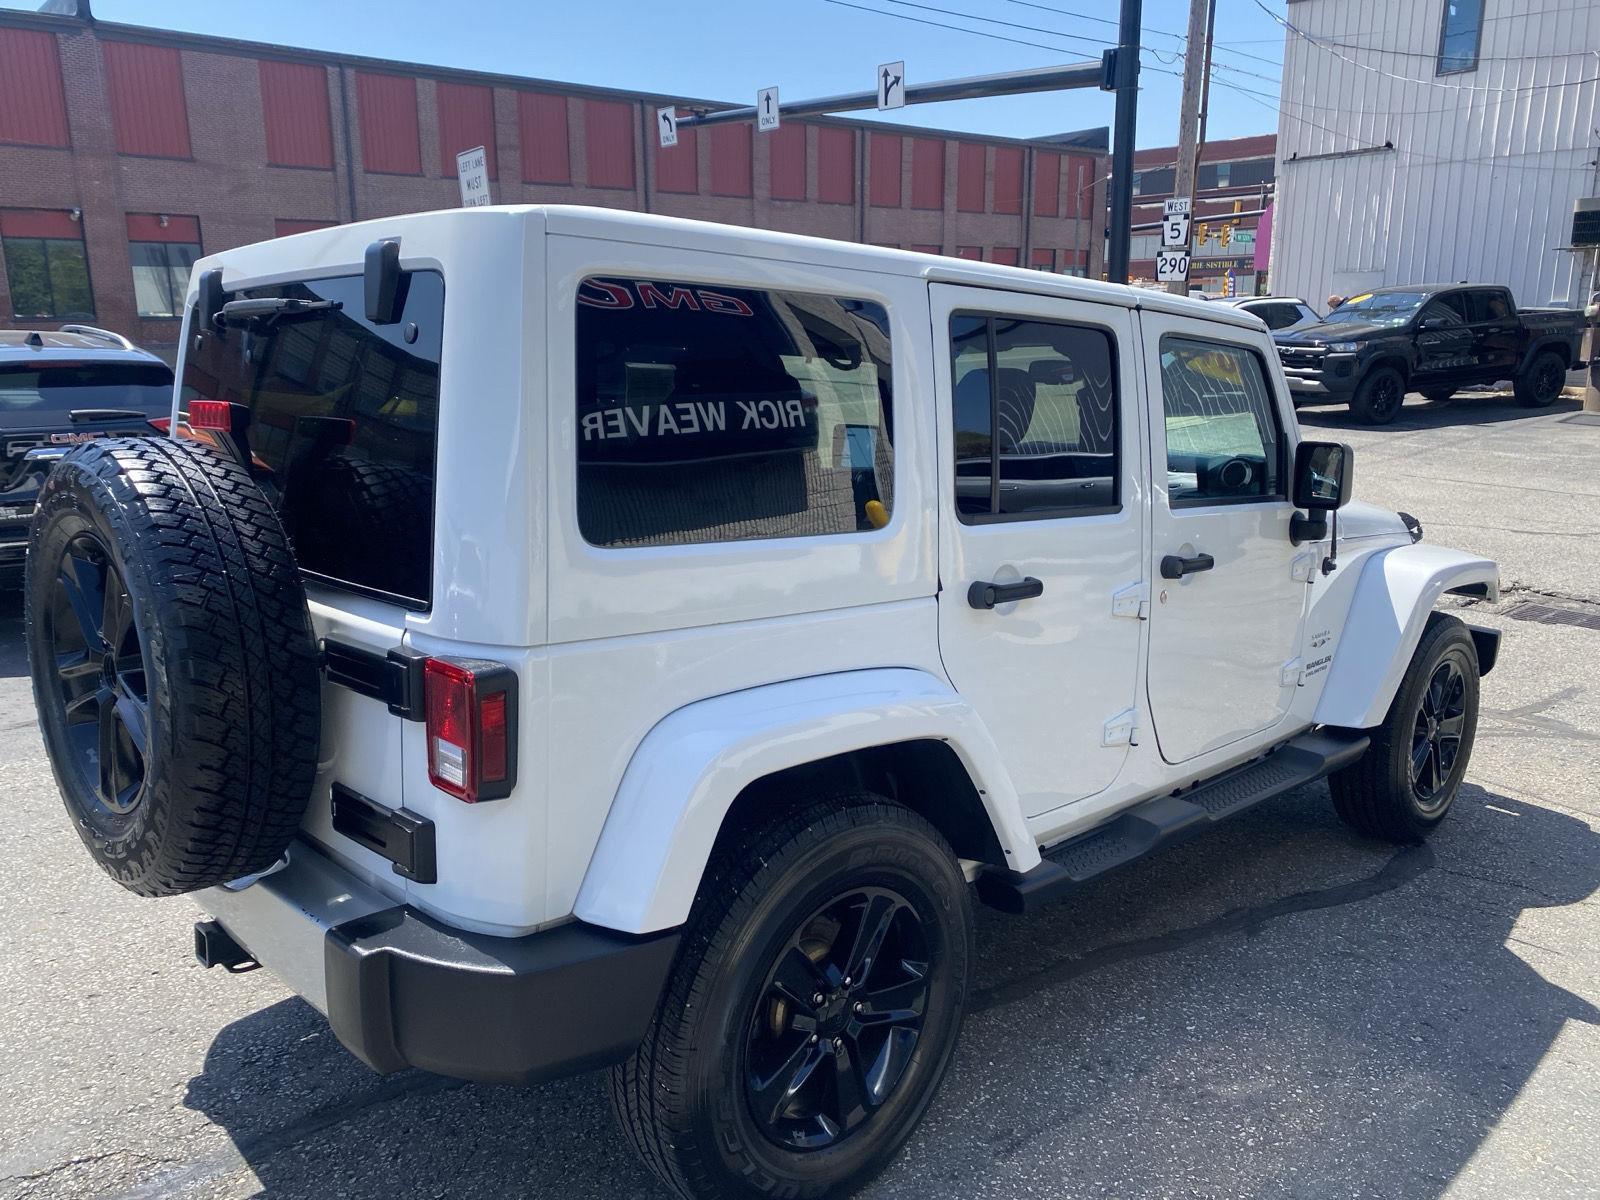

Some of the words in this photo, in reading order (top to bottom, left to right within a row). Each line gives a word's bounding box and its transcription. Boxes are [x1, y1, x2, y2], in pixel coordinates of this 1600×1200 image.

[761, 115, 776, 126] ONLY
[662, 134, 675, 144] ONLY
[460, 160, 471, 173] LEFT
[472, 156, 484, 169] LANE
[466, 176, 482, 191] MUST
[1167, 201, 1189, 212] WEST
[1170, 222, 1181, 239] 5
[1158, 257, 1187, 274] 290
[1191, 260, 1239, 270] RIE-SISTIBLE
[51, 432, 105, 445] GMC
[1306, 655, 1332, 670] RANGLER
